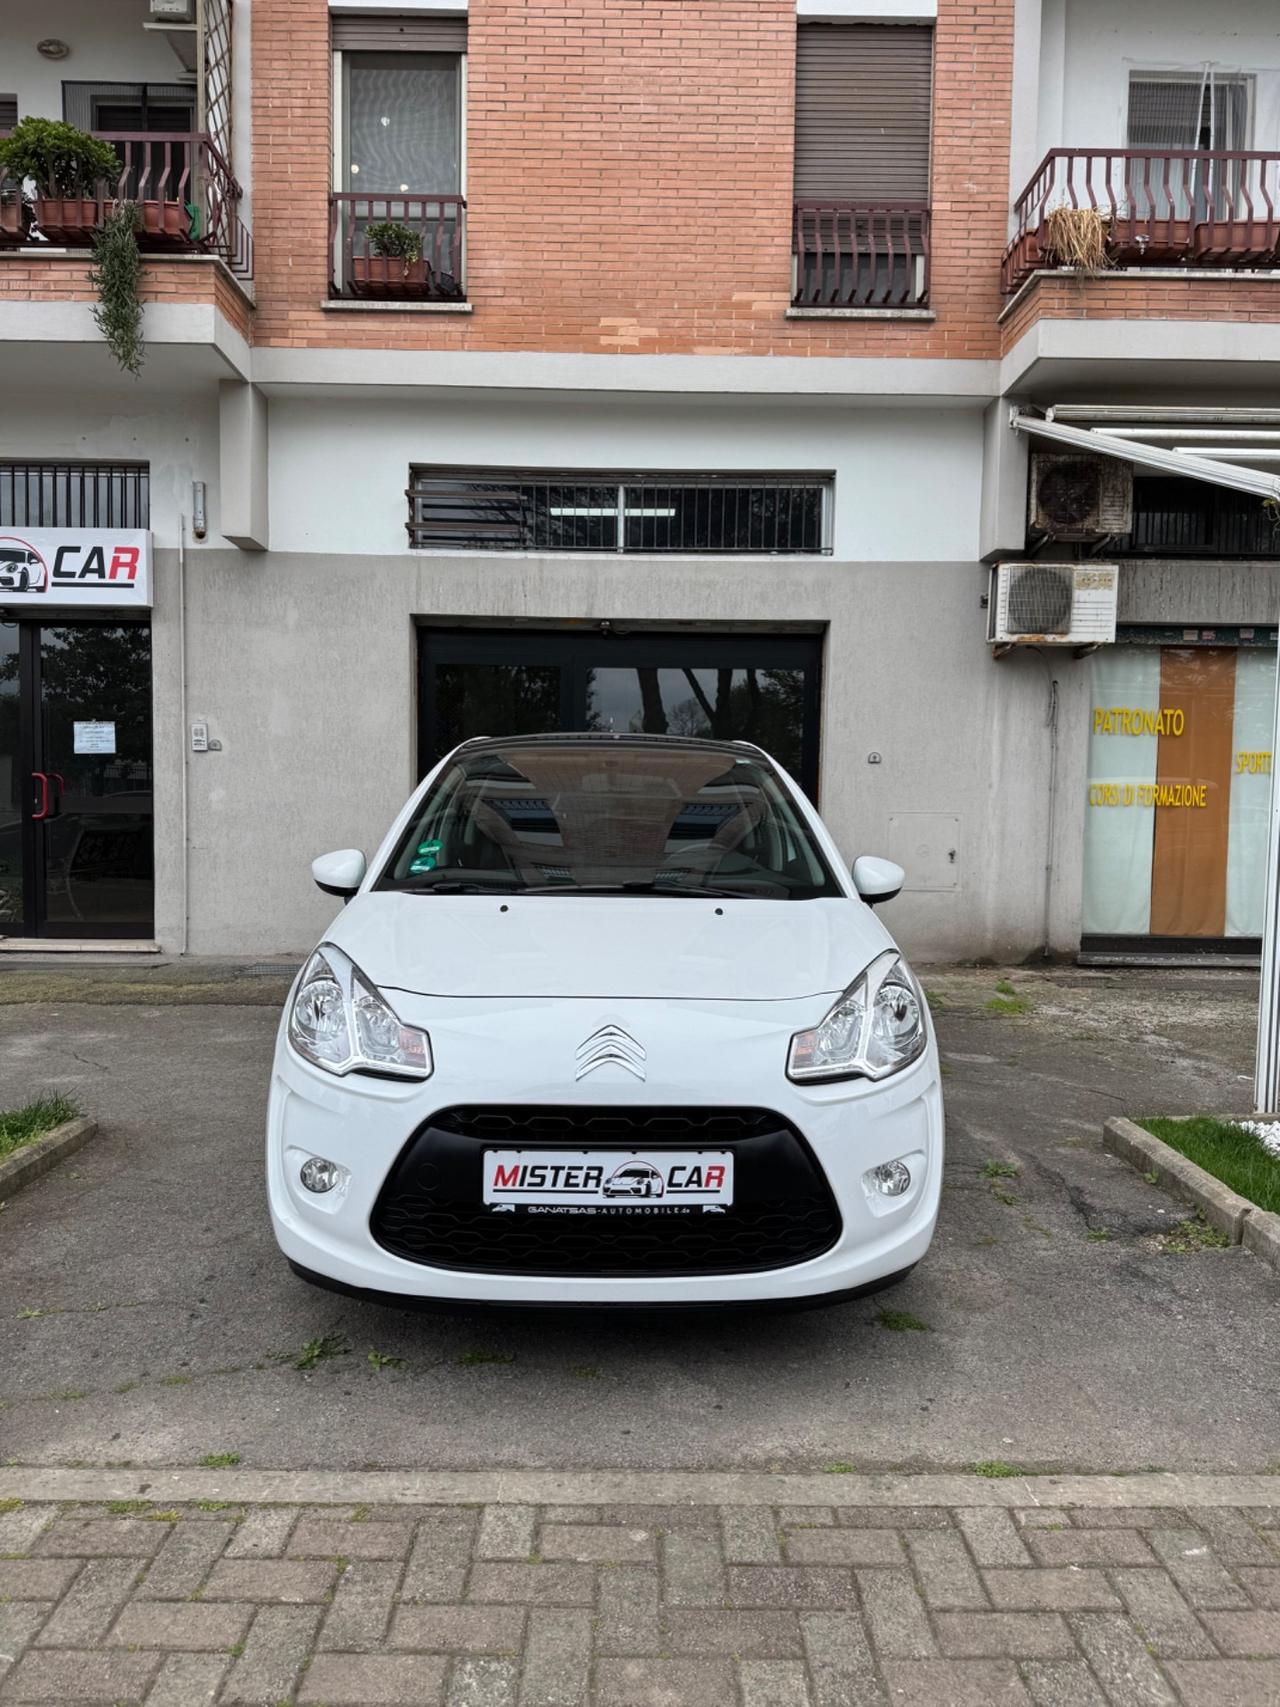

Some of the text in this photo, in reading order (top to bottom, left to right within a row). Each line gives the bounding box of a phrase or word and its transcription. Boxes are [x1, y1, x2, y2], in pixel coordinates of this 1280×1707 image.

[52, 545, 140, 580] CAR
[1093, 707, 1185, 736] PATRONATO
[1089, 783, 1208, 807] CORSI DI FORMAZIONE
[493, 1164, 726, 1188] MISTER CAR
